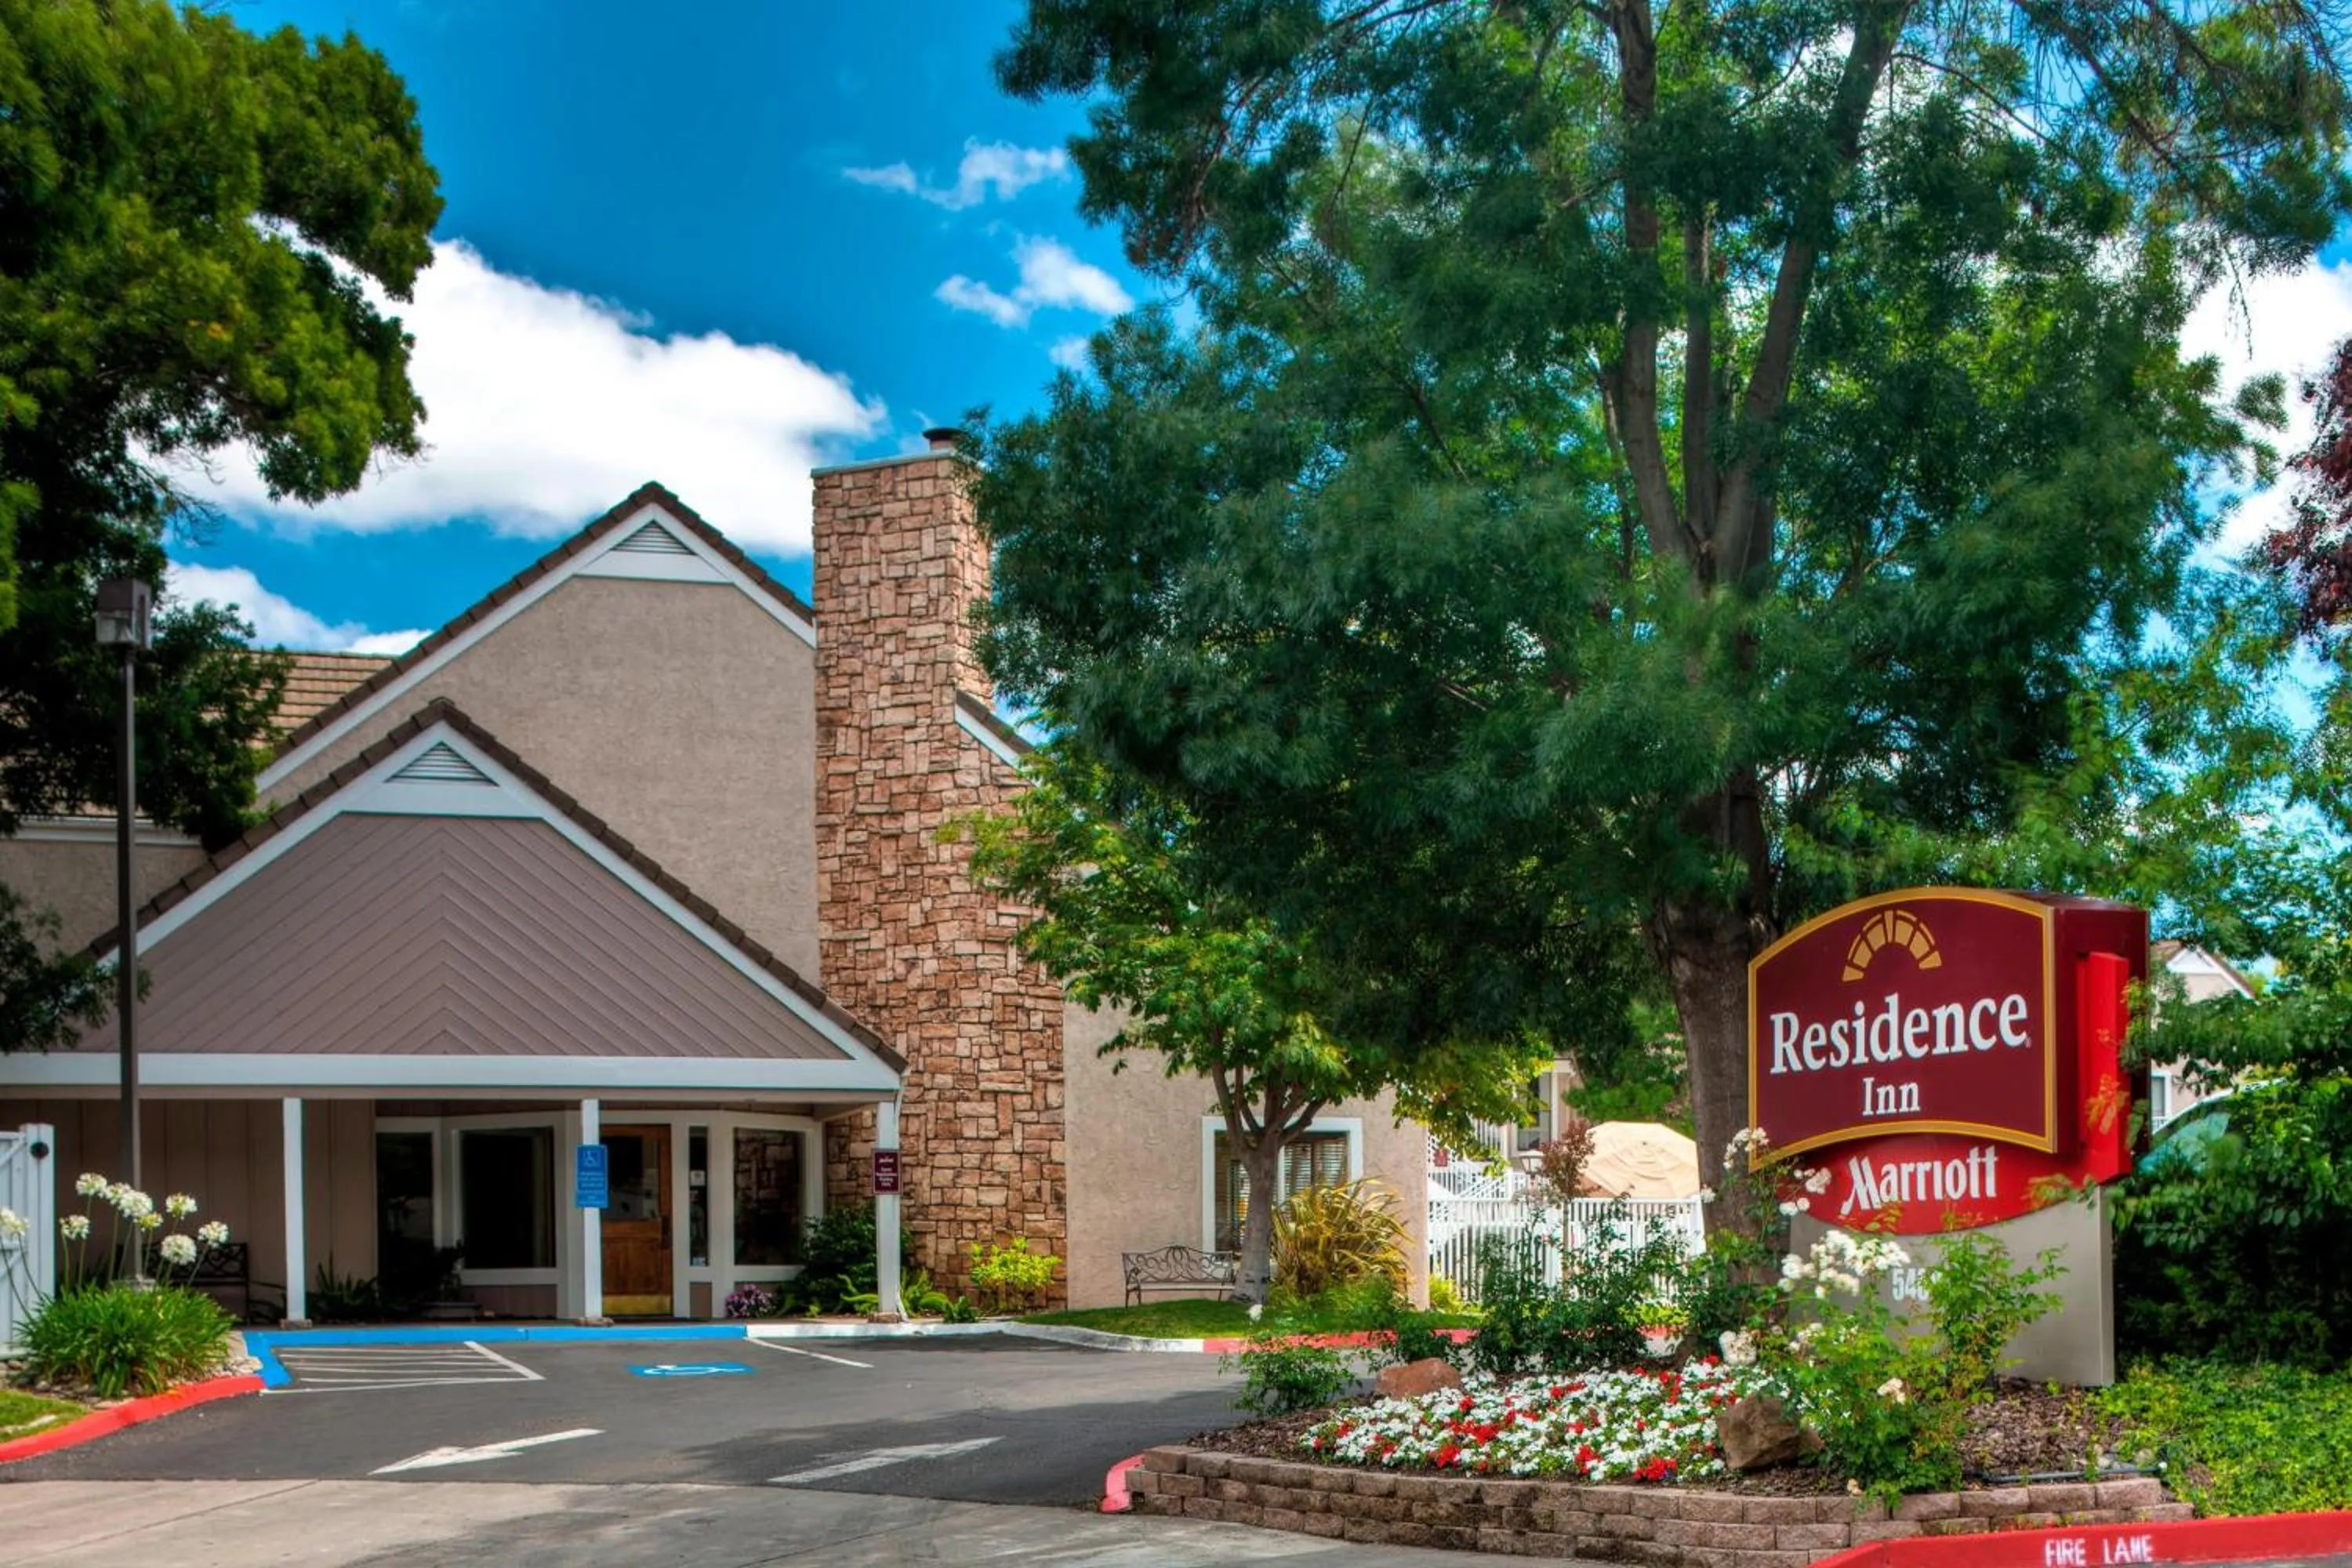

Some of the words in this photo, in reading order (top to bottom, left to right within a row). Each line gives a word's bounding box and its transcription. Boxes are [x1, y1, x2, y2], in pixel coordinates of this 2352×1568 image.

[1769, 992, 2028, 1075] Residence
[1862, 1076, 1920, 1116] Inn
[1839, 1145, 1999, 1217] Marriott
[2045, 1537, 2087, 1567] FIRE
[2103, 1534, 2154, 1565] LANE
